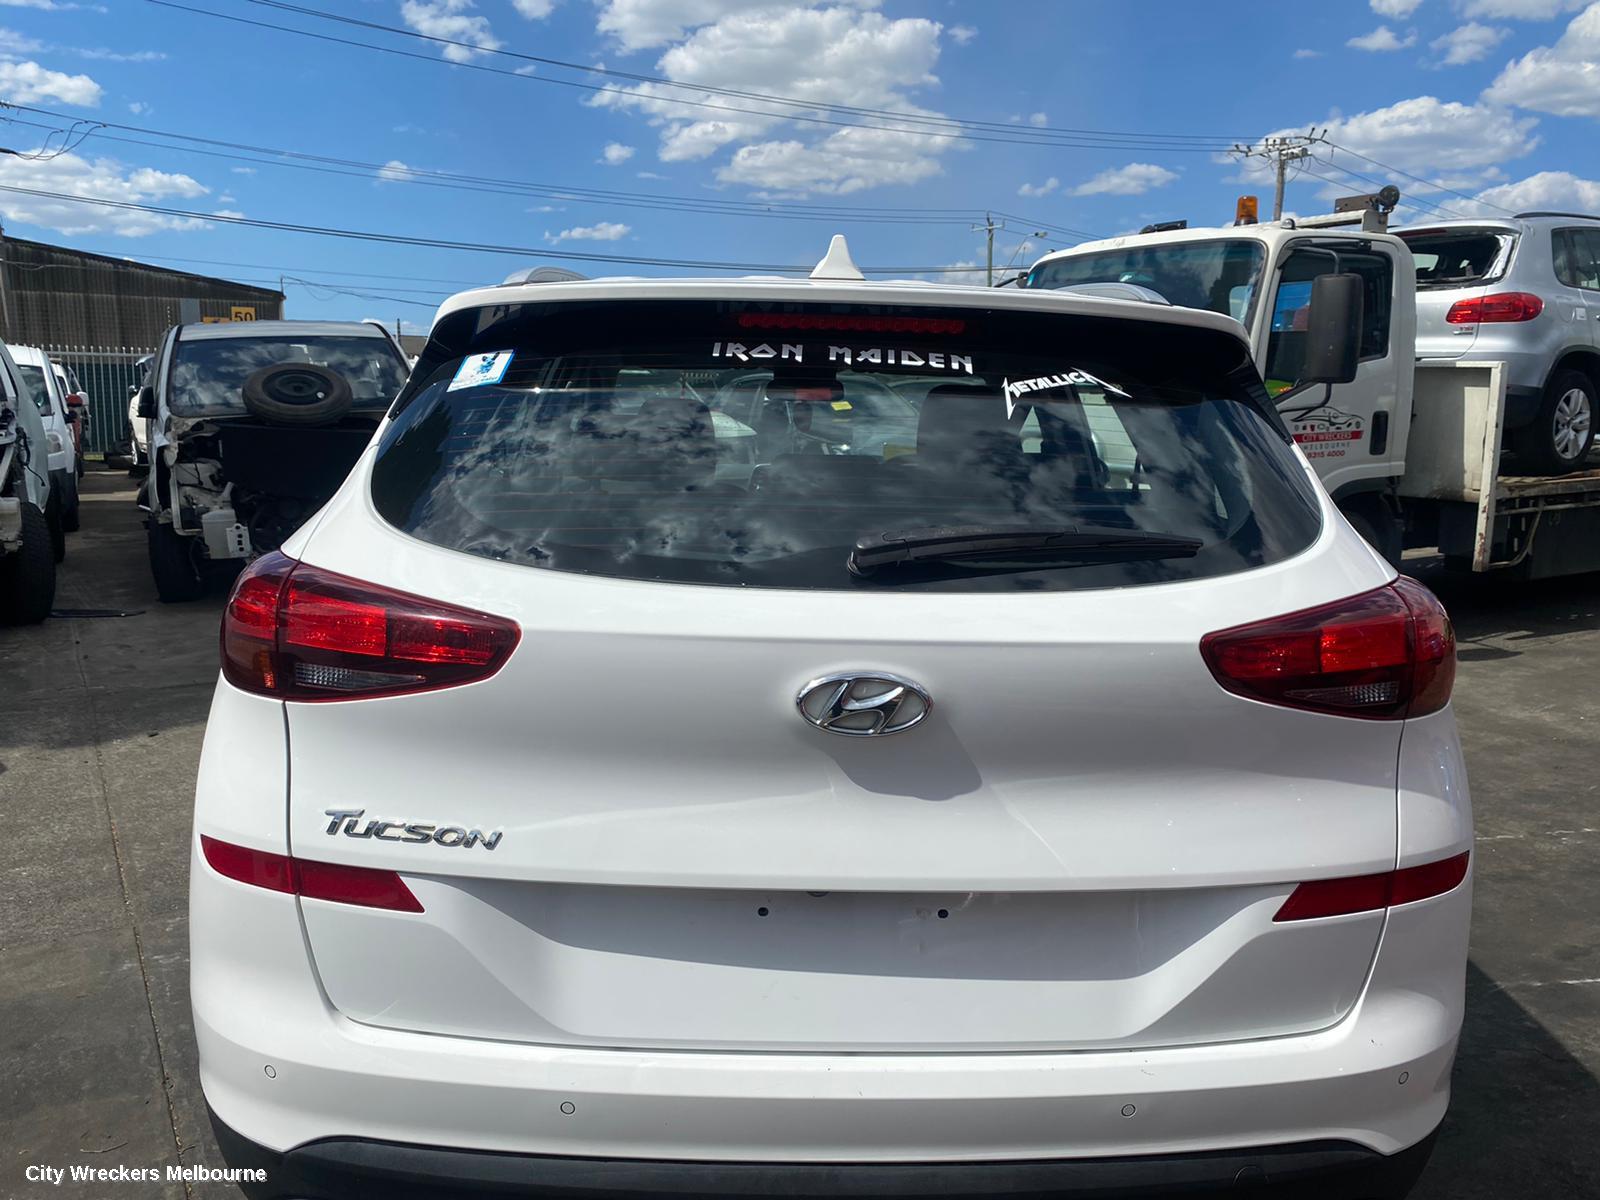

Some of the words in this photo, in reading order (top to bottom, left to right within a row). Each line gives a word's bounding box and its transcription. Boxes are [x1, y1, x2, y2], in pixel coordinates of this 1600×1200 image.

[234, 311, 253, 322] 50
[712, 342, 803, 363] IRON
[828, 345, 973, 375] MAIDEN
[1001, 367, 1132, 420] METALLICA
[324, 808, 503, 851] TUCSON
